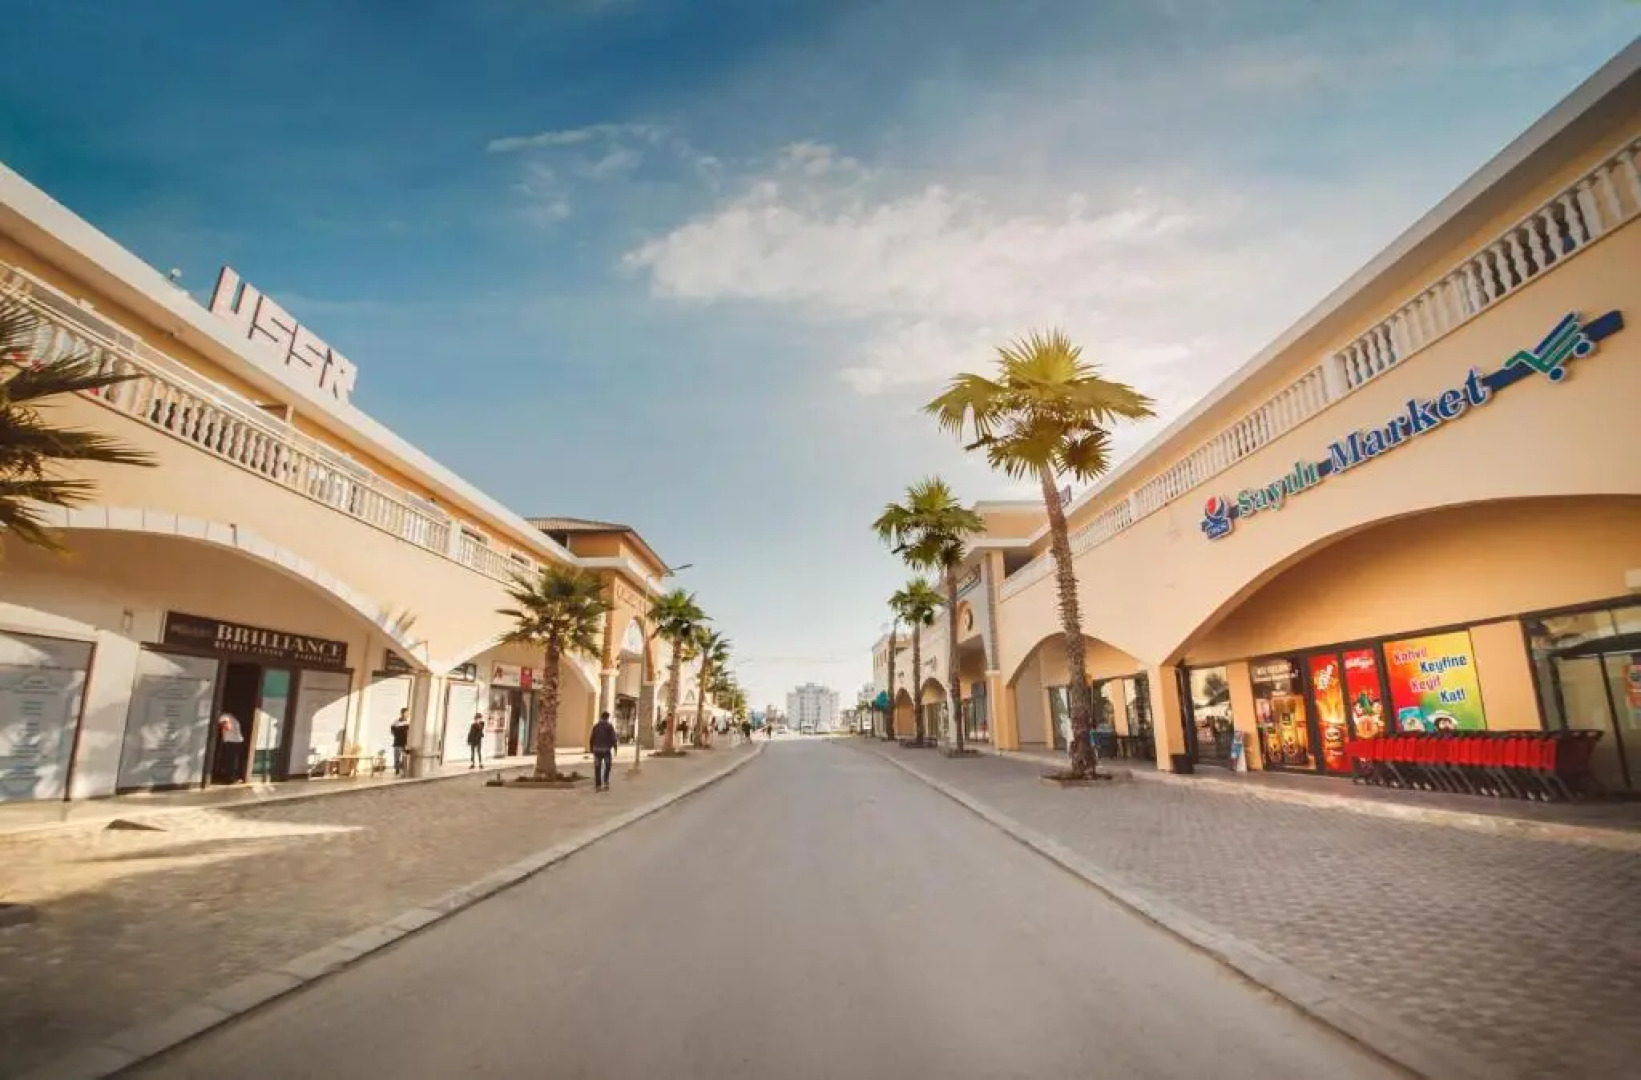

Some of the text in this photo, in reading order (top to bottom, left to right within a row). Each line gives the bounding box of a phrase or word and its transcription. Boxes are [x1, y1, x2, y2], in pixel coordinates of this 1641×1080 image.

[1326, 367, 1490, 474] Market
[217, 624, 341, 657] BRILLIANCE
[1420, 656, 1467, 673] Keyfine
